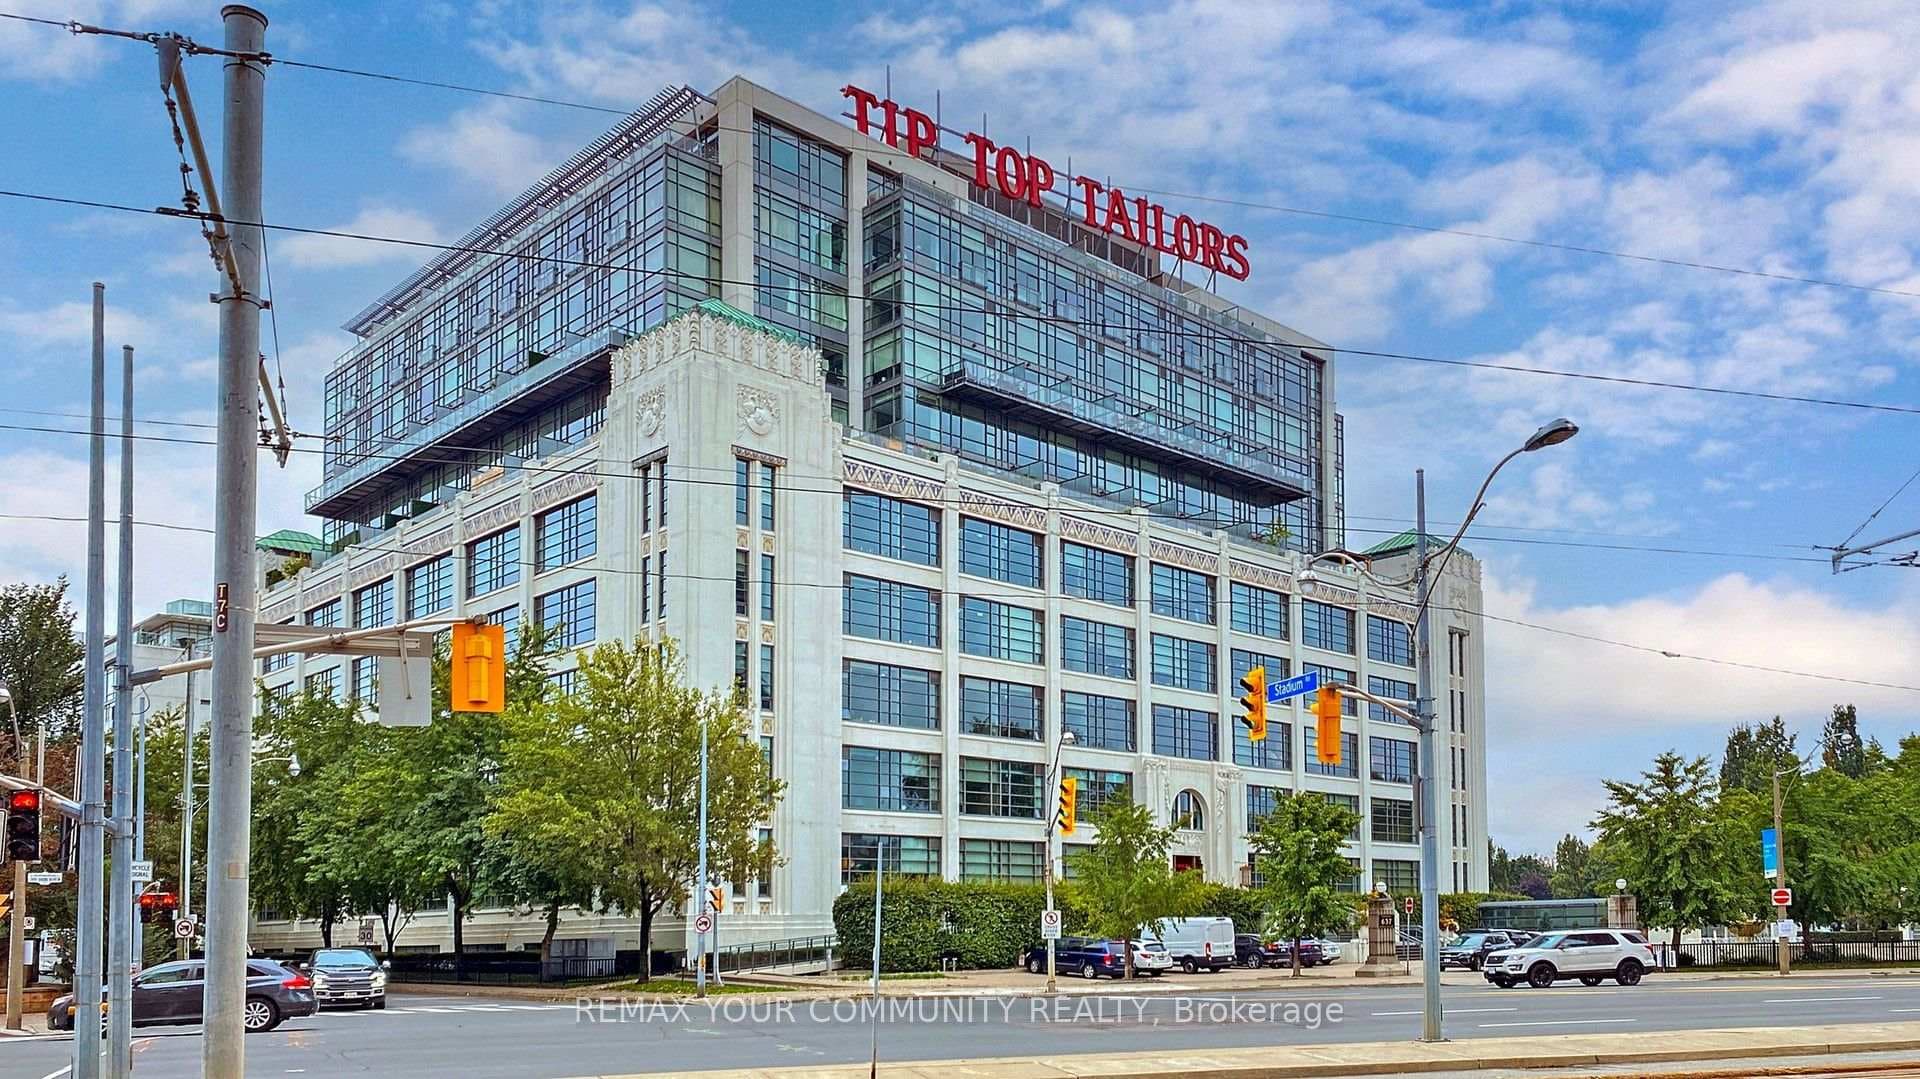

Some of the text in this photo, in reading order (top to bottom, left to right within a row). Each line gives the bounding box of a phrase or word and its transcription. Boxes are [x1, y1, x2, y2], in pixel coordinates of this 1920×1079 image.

[840, 84, 1251, 281] TIP TOP TAILORS
[1274, 680, 1303, 697] Stadium
